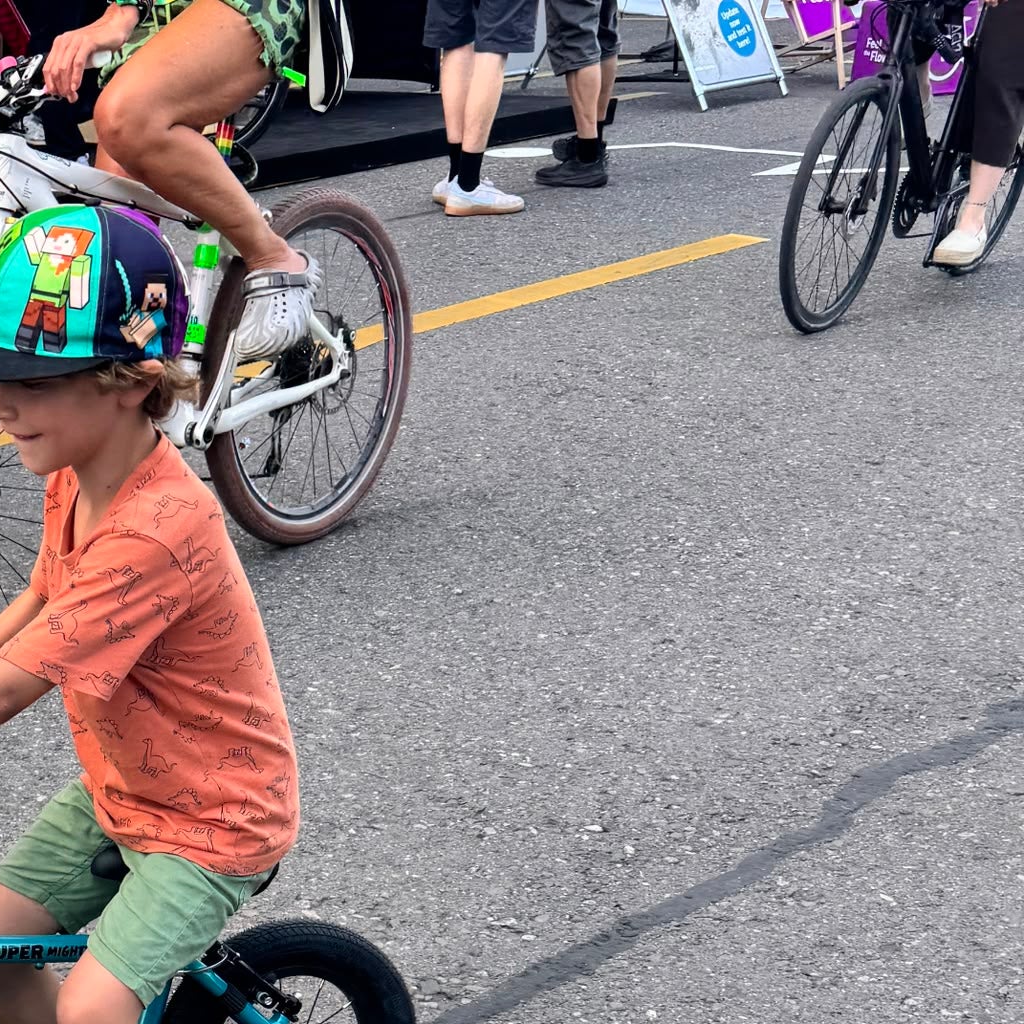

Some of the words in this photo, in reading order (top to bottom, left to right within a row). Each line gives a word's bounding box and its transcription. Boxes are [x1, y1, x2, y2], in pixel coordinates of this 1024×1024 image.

[720, 7, 740, 20] Update
[729, 18, 741, 29] now
[727, 30, 738, 42] and
[736, 35, 751, 49] here!
[866, 37, 883, 50] Feel
[47, 944, 88, 959] MIGHT
